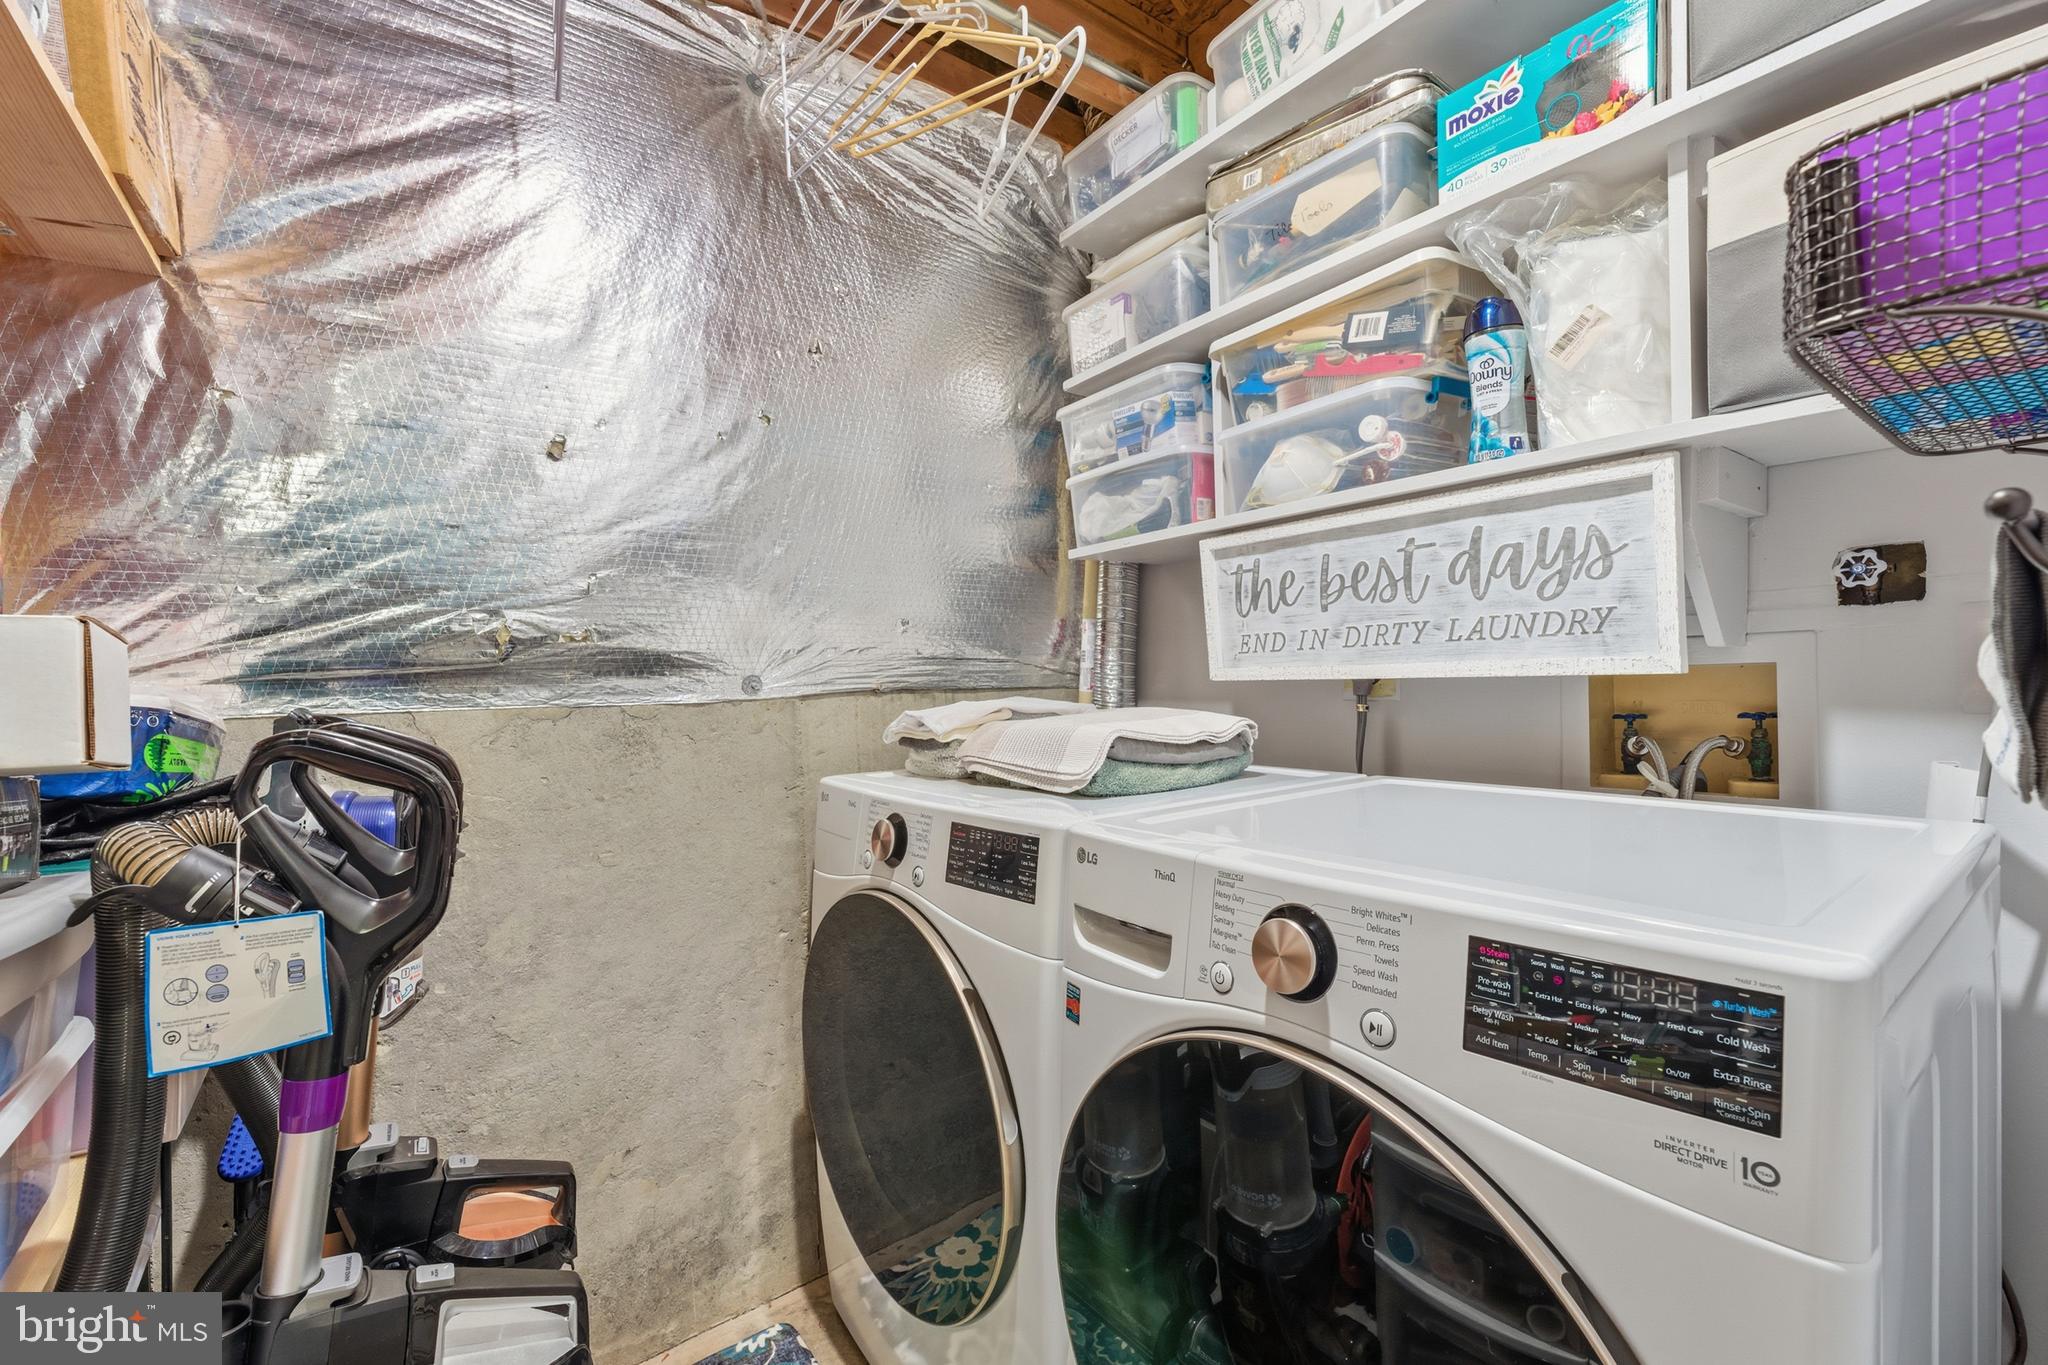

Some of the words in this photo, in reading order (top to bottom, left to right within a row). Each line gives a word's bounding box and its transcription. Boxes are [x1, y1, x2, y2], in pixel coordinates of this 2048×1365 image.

[1448, 86, 1521, 136] moxie
[1490, 158, 1508, 174] 39
[1447, 178, 1464, 193] 40
[1300, 201, 1333, 222] Tools
[1469, 365, 1512, 385] Downy
[1475, 381, 1503, 393] Blends
[1222, 557, 1305, 619] the
[1319, 537, 1437, 613] best
[1447, 523, 1630, 602] days
[1238, 631, 1287, 655] END
[1296, 628, 1330, 652] IN
[1342, 619, 1432, 649] DIRTY
[1445, 606, 1618, 642] LAUNDRY
[1087, 851, 1098, 865] LG
[1154, 869, 1176, 883] ThinQ
[1217, 878, 1235, 889] Normal
[1215, 890, 1231, 900] Heavy
[1232, 893, 1245, 904] Duty
[1214, 902, 1235, 915] Bedding
[1351, 905, 1373, 919] Bright
[1213, 915, 1234, 928] Sanitary
[1366, 922, 1401, 937] Delicates
[1212, 940, 1220, 950] Tub
[1221, 943, 1236, 955] Clean
[1356, 936, 1377, 948] Perm.
[1379, 940, 1400, 953] Press
[1486, 948, 1509, 959] Steam
[1374, 954, 1399, 968] Towels
[1550, 962, 1565, 972] Wash
[1352, 965, 1376, 978] Speed
[1378, 971, 1398, 983] Wash
[1569, 967, 1585, 976] Rinse
[1591, 971, 1604, 980] Spin
[1352, 980, 1398, 999] Downloaded
[1478, 976, 1510, 990] Pre-wash
[1535, 992, 1550, 1001] Extra
[1551, 994, 1563, 1003] Hot
[1473, 1005, 1493, 1017] Delay
[1494, 1009, 1514, 1022] Wash
[1575, 1001, 1591, 1011] Extra
[1592, 1004, 1607, 1014] High
[1621, 1011, 1642, 1022] Heavy
[1574, 1023, 1599, 1034] Medium
[1667, 1021, 1686, 1033] Fresh
[1687, 1025, 1704, 1036] Care
[1475, 1035, 1490, 1046] Add
[1492, 1038, 1509, 1050] Item
[1534, 1034, 1544, 1043] Tap
[1545, 1037, 1558, 1046] Cold
[1620, 1033, 1645, 1046] Normal
[1716, 1034, 1740, 1047] Cold
[1742, 1039, 1770, 1054] Wash
[1528, 1048, 1550, 1062] Temp.
[1574, 1044, 1583, 1052] No
[1584, 1046, 1598, 1056] Spin
[1573, 1060, 1591, 1072] Spin
[1620, 1056, 1637, 1066] Light
[1582, 1071, 1595, 1081] Only
[1620, 1074, 1637, 1086] Soil
[1665, 1067, 1690, 1079] On/Off
[1713, 1069, 1740, 1083] Extra
[1743, 1076, 1772, 1091] Rinse
[1664, 1086, 1693, 1101] Signal
[1713, 1097, 1771, 1121] Rinse+Spin
[1747, 1116, 1764, 1127] Lock
[1665, 1134, 1716, 1154] INVERTER
[1654, 1139, 1691, 1159] DIRECT
[1694, 1150, 1728, 1169] DRIVE
[1677, 1157, 1704, 1169] MOTOR
[1740, 1157, 1781, 1188] 10
[1742, 1182, 1779, 1196] WARRANTY
